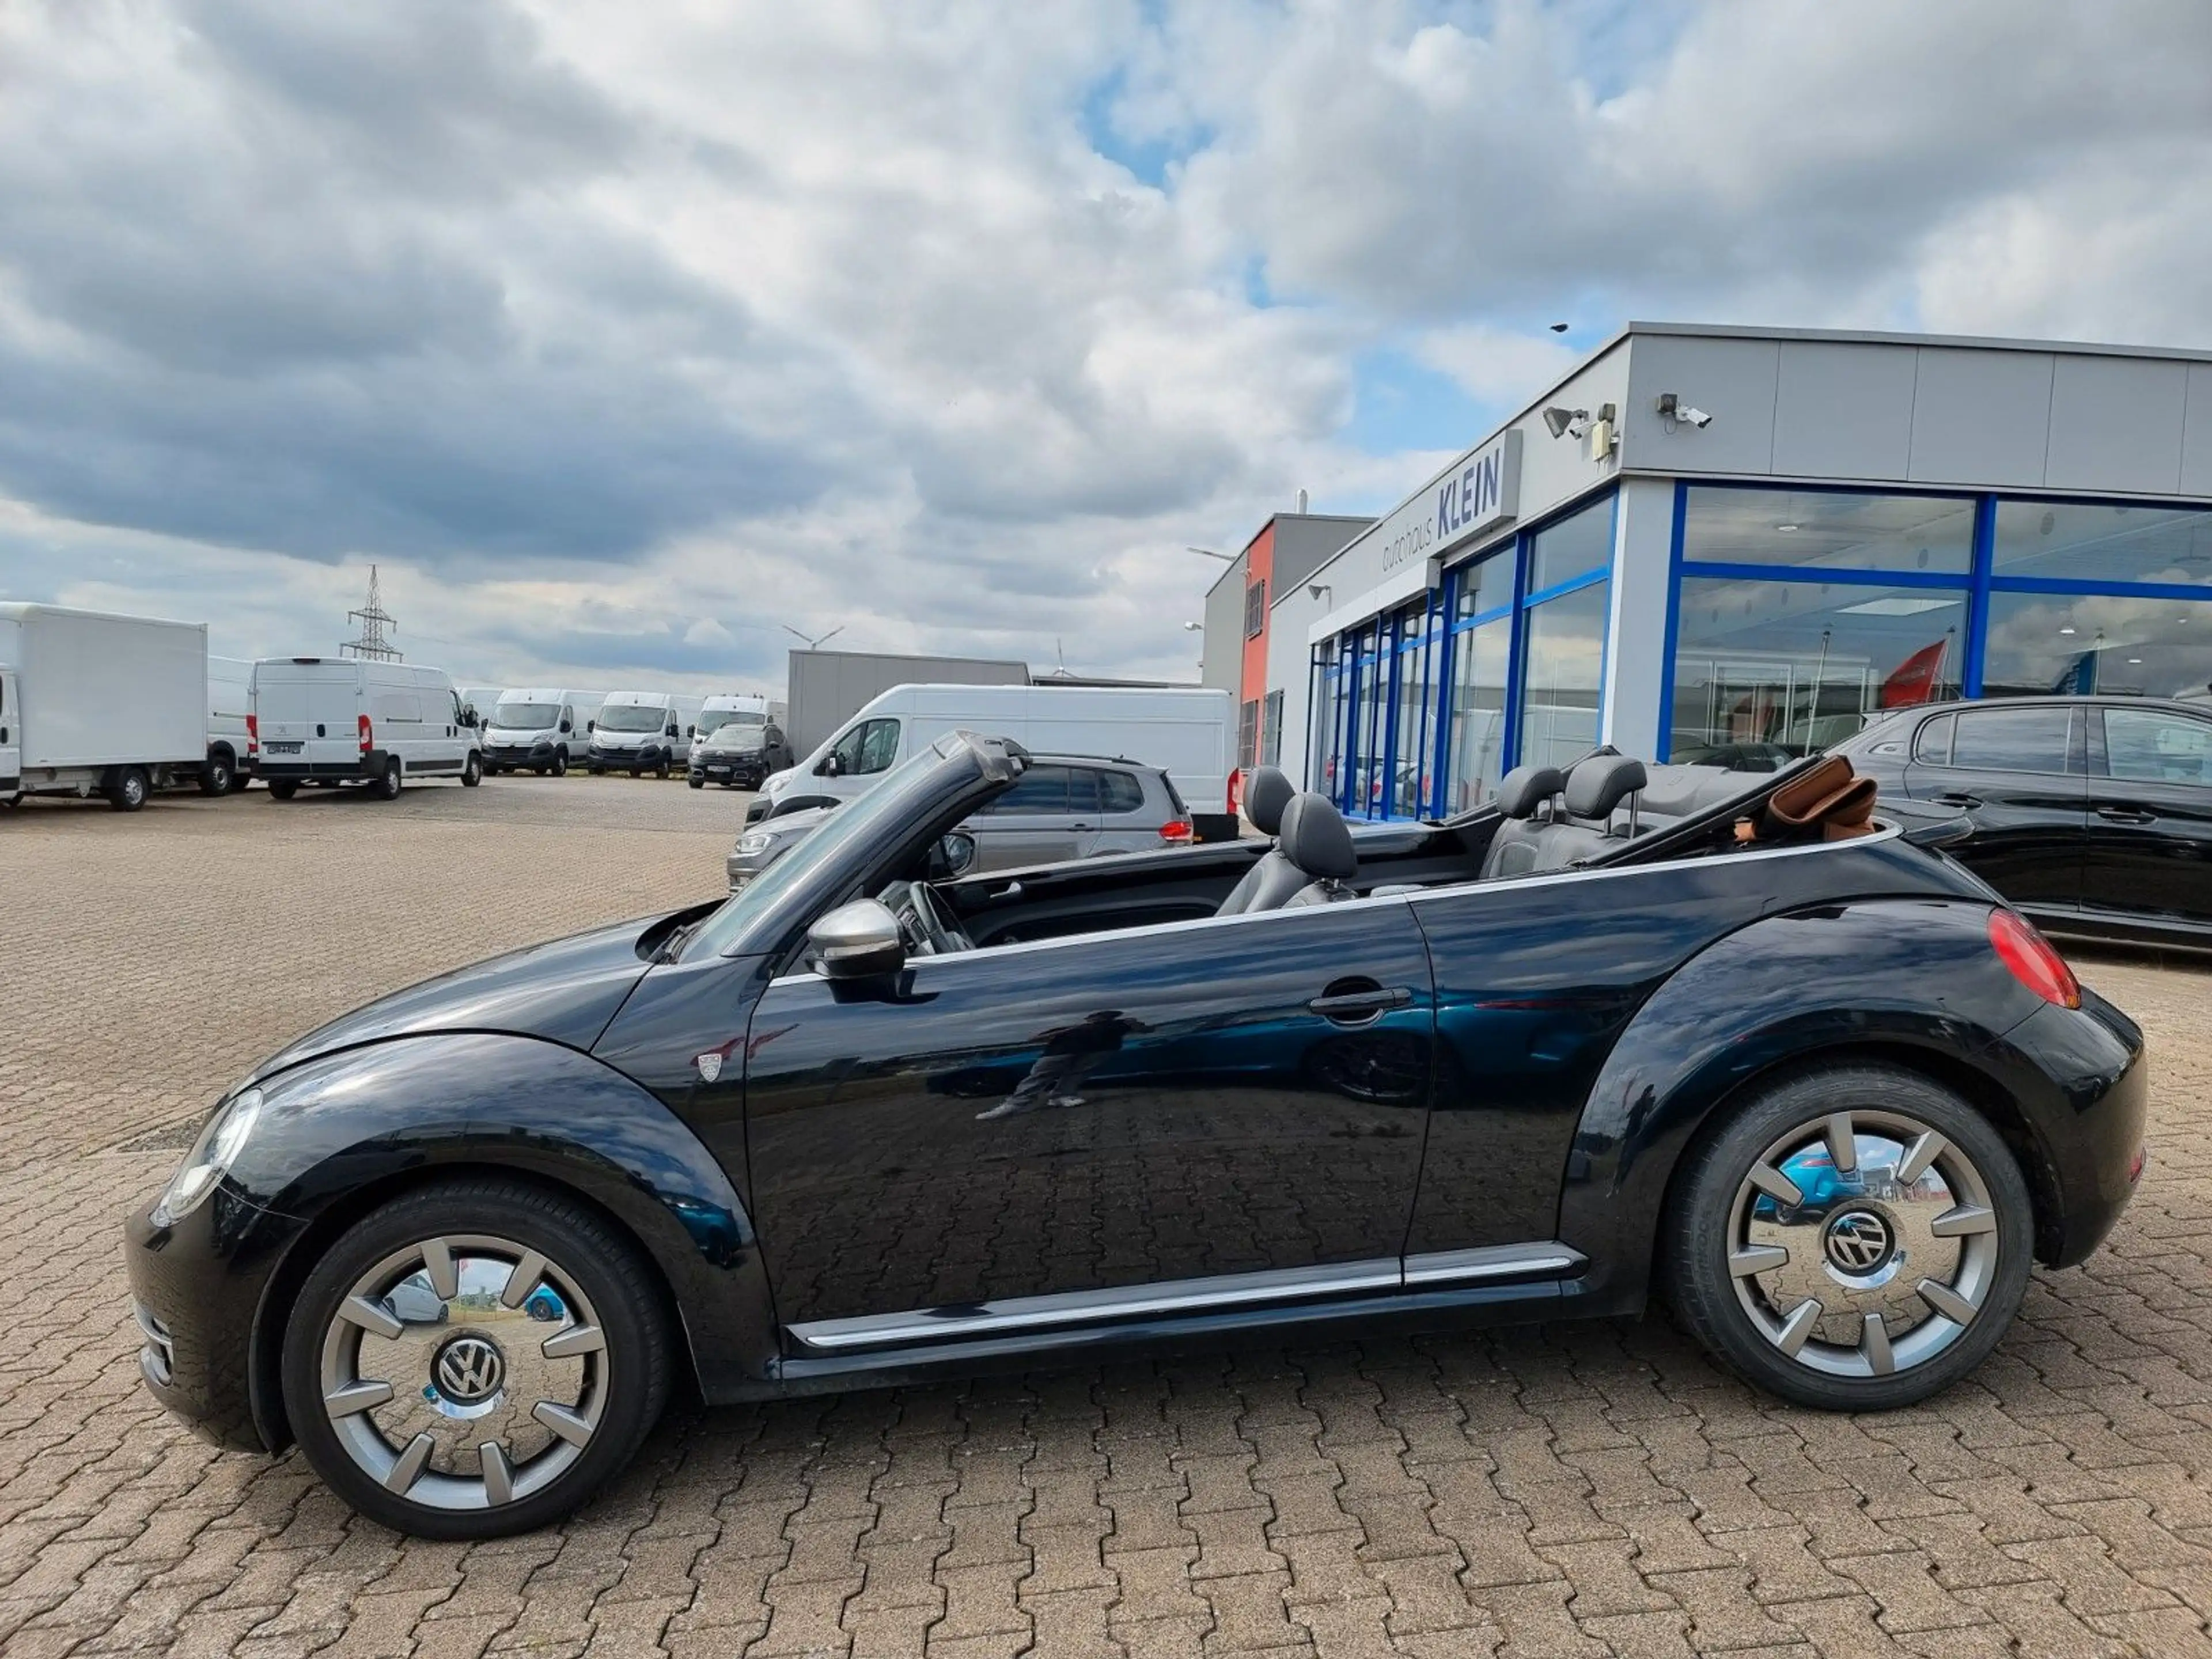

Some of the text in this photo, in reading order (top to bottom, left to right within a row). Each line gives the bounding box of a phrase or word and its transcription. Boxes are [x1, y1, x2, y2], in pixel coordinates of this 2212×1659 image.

[1383, 448, 1499, 572] autohaus KLEIN
[439, 1339, 501, 1398] VW
